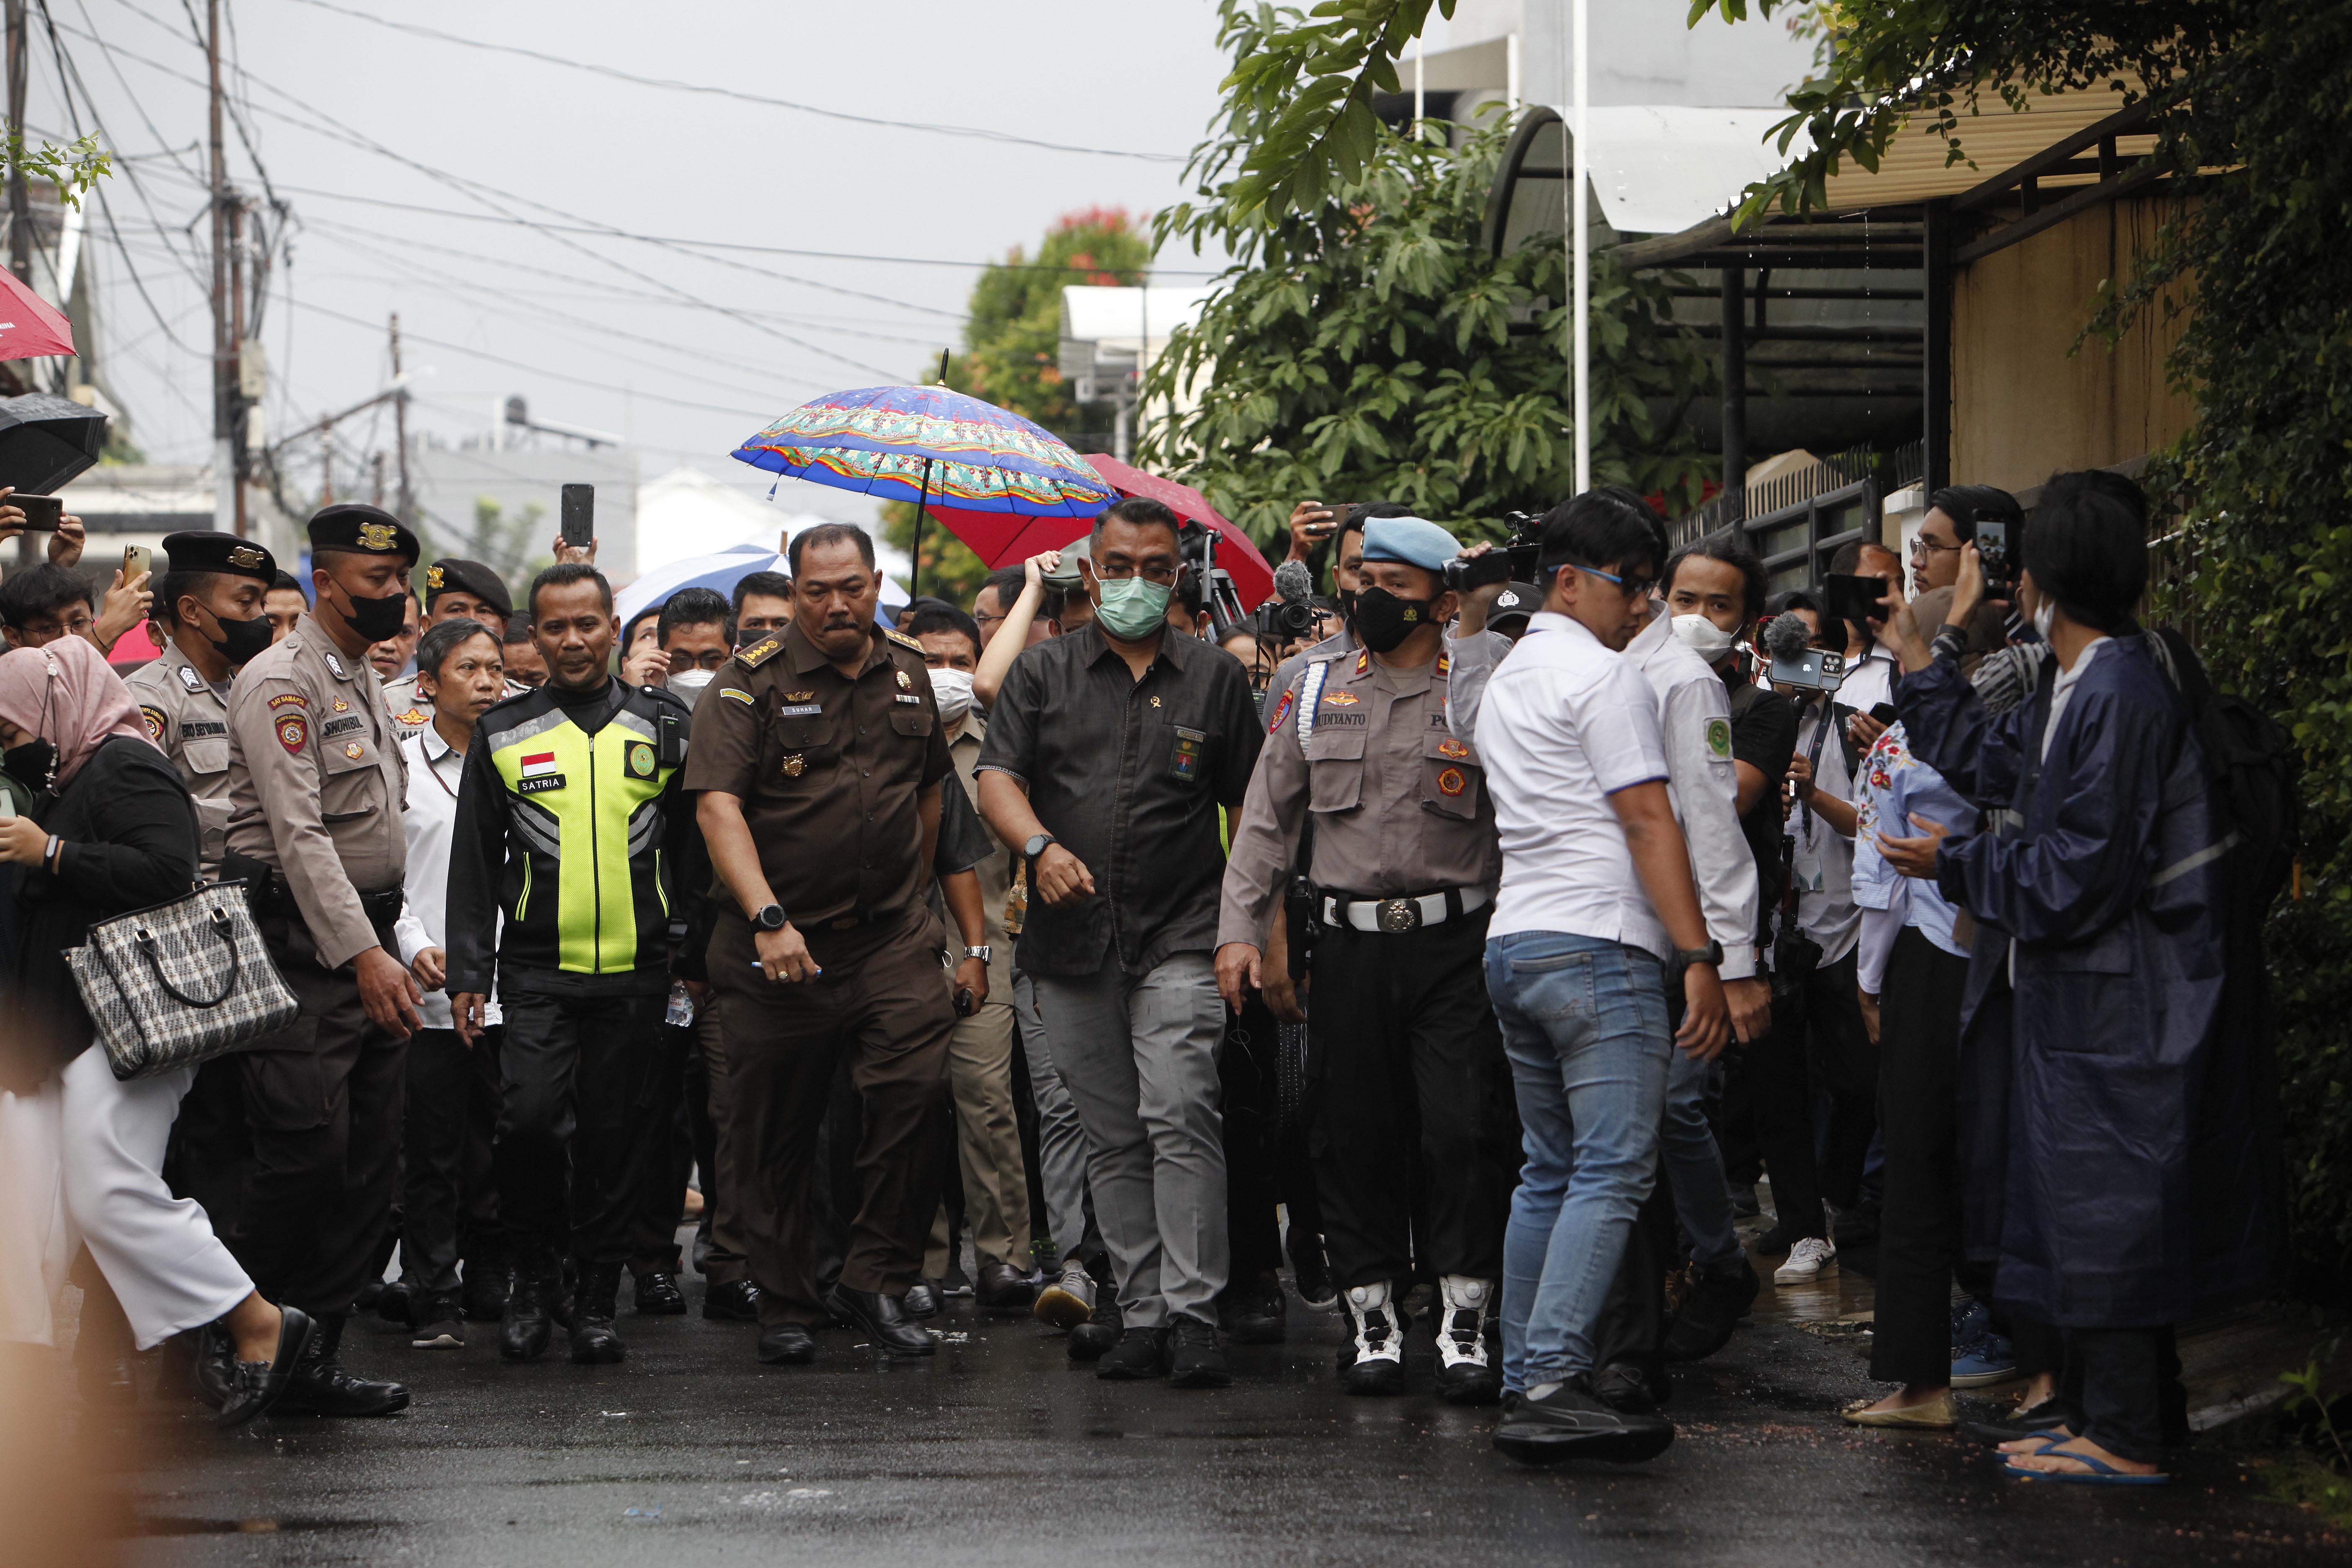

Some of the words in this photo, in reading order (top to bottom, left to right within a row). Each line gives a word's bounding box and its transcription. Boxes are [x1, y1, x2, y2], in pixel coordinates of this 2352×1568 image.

[738, 654, 756, 665] JAKSA
[271, 698, 281, 706] SAT
[281, 696, 304, 706] SAMAPTA
[324, 716, 364, 736] SHOHIBUL
[523, 779, 559, 790] SATRIA
